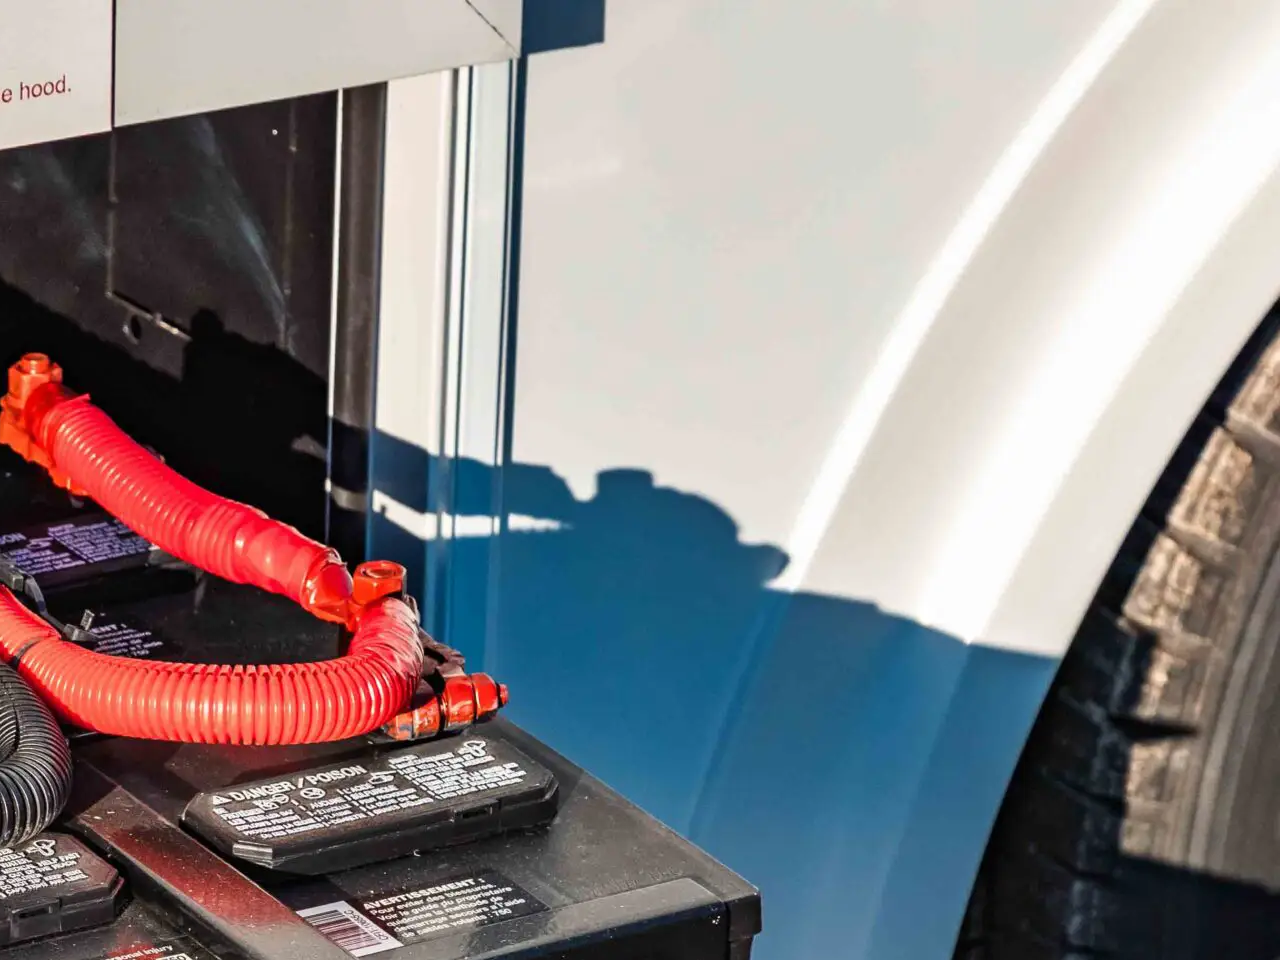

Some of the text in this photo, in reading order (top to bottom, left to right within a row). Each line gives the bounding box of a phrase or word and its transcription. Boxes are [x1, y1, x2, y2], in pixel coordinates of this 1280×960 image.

[19, 74, 72, 100] hood.
[228, 780, 296, 802] DANGER
[306, 765, 368, 785] POISON
[363, 878, 476, 910] AVERTISSEMENT
[370, 906, 395, 916] Pour
[397, 898, 424, 910] eviter
[426, 894, 445, 903] des
[377, 912, 398, 921] Voir
[411, 902, 440, 915] guide
[455, 886, 513, 905] proprietaire
[445, 899, 488, 914] methode
[490, 896, 504, 905] de
[393, 915, 448, 933] demarrage
[449, 907, 488, 919] secours
[401, 930, 415, 938] de
[492, 908, 512, 917] 750
[144, 944, 173, 957] injury
